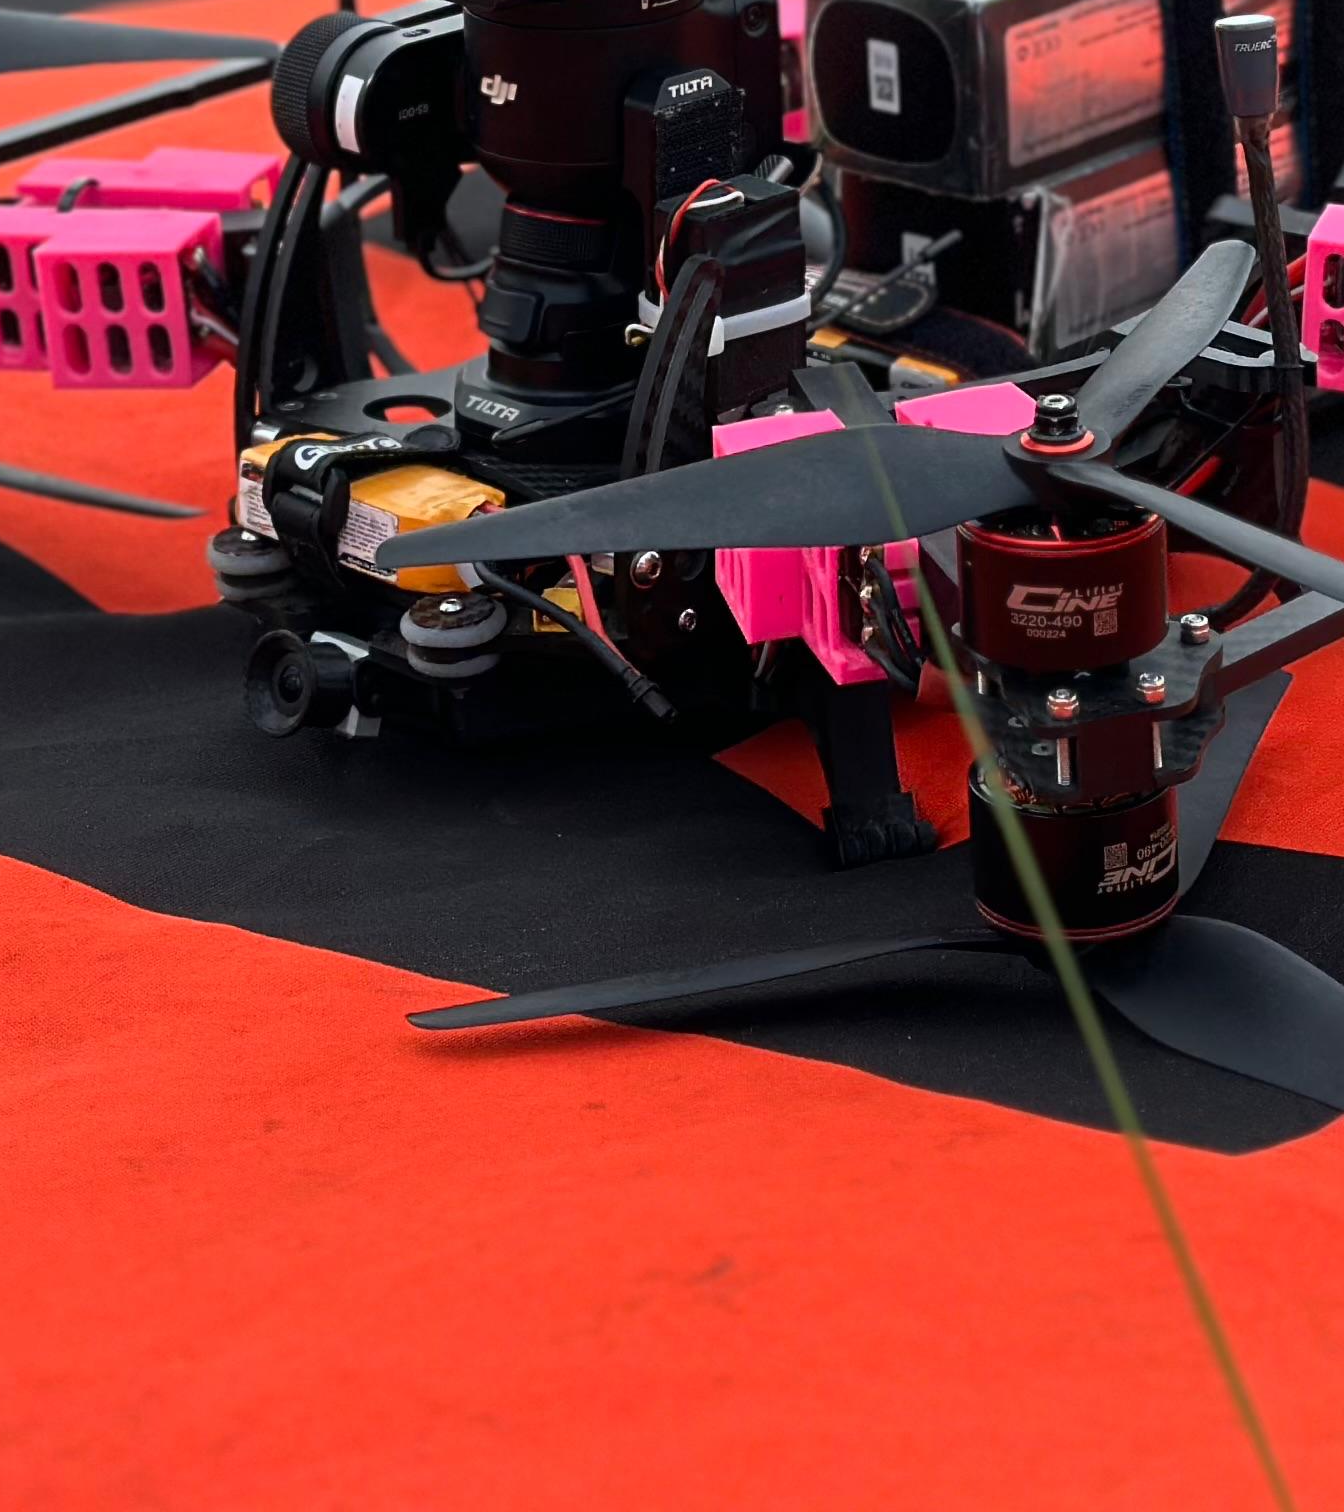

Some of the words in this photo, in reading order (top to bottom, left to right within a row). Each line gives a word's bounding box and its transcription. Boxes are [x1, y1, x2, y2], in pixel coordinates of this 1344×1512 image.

[668, 75, 713, 99] TILTA
[465, 394, 521, 422] TILTA
[1010, 612, 1083, 628] 3220-490
